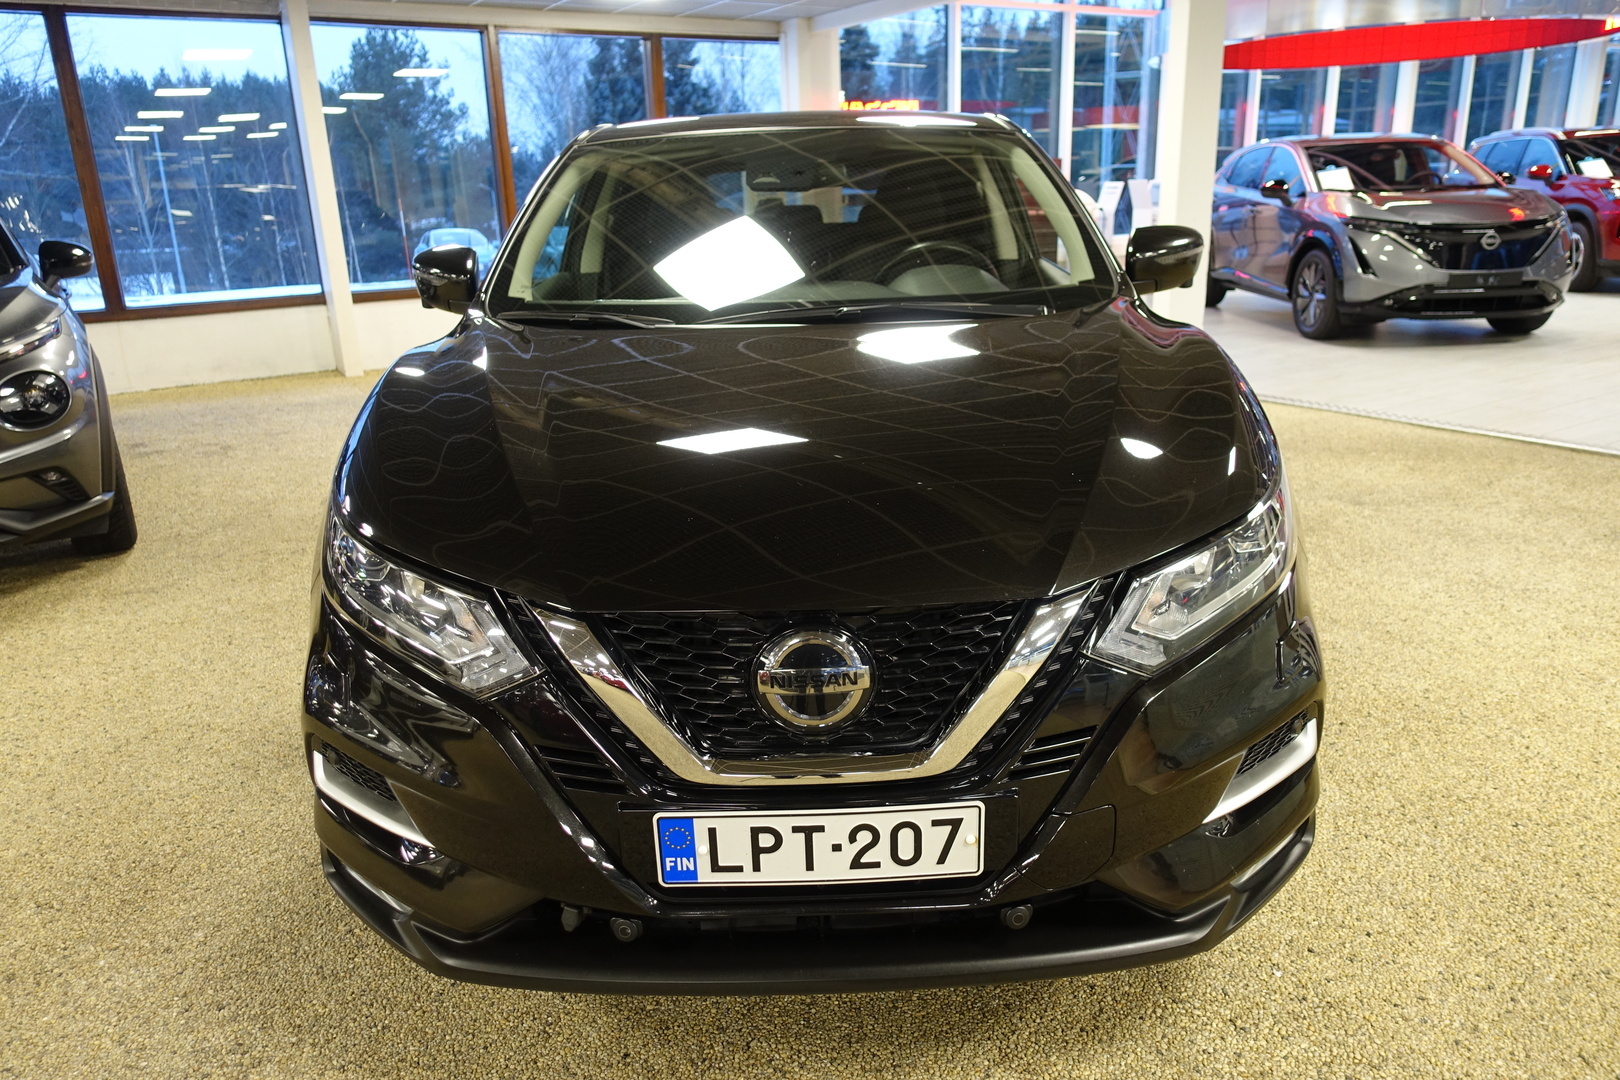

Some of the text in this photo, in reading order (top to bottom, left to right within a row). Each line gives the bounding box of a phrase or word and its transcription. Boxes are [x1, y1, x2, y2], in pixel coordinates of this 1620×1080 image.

[769, 671, 859, 689] NISSAN
[707, 817, 965, 874] LPT-207
[665, 857, 695, 872] FIN
